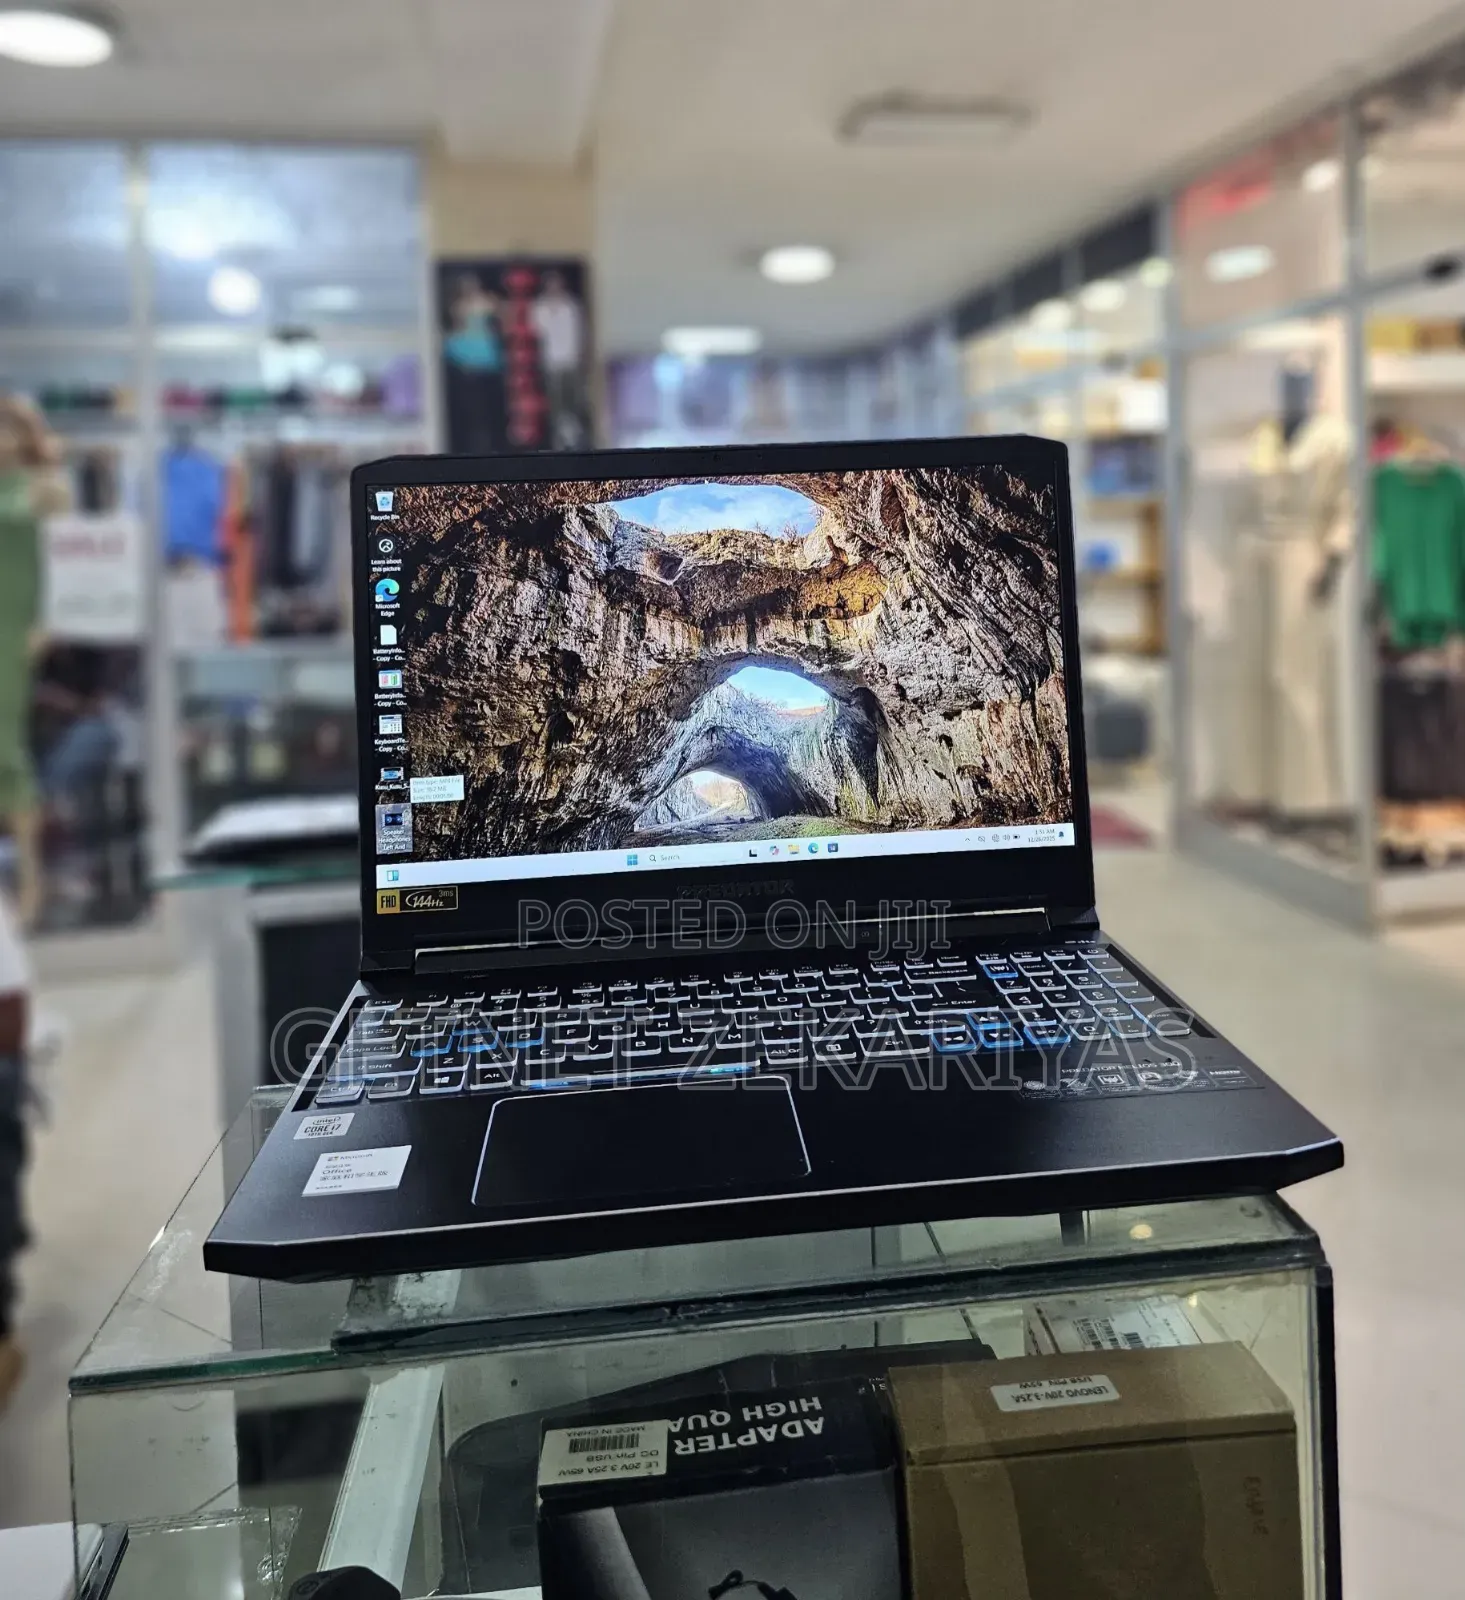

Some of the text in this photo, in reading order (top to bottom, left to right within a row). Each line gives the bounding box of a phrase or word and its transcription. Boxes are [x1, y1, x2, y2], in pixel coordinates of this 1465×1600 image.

[438, 889, 454, 898] 3ms
[380, 894, 444, 909] FHD 144Hz
[1061, 1065, 1117, 1074] PREDATOR
[1118, 1062, 1157, 1070] HELIOS
[304, 1125, 330, 1134] CORE
[1066, 1385, 1109, 1399] LENOVO
[742, 1396, 825, 1423] HIGH
[567, 1428, 600, 1438] CHINA
[619, 1424, 647, 1434] MADE
[674, 1416, 825, 1456] ADAPTER
[586, 1453, 614, 1463] USB
[640, 1449, 660, 1458] DC
[645, 1460, 659, 1469] LE
